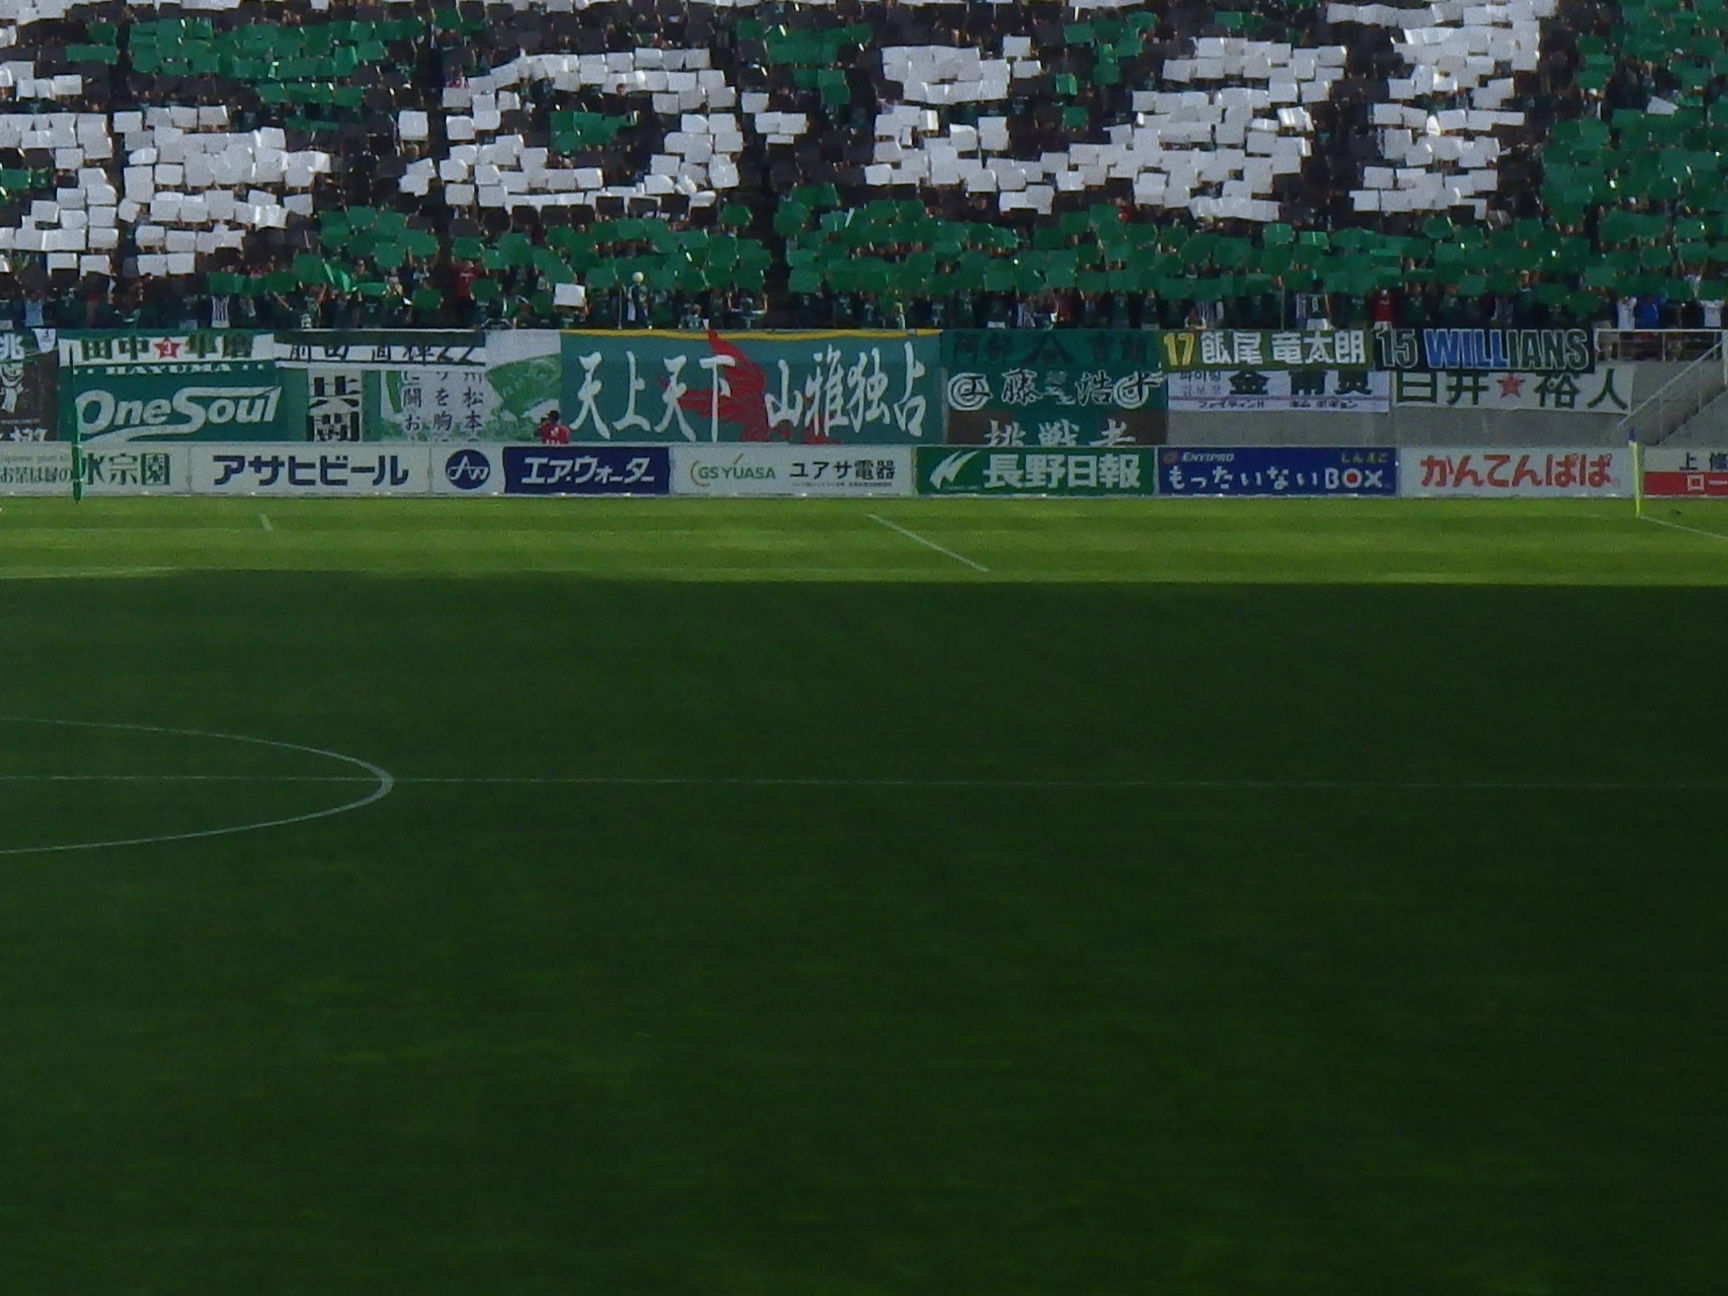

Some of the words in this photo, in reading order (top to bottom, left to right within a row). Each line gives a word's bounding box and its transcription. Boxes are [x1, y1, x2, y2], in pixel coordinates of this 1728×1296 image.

[1164, 331, 1194, 367] 17
[1272, 330, 1366, 365] 竜太朗
[1376, 328, 1418, 369] 15
[1423, 328, 1590, 370] WILLIANS
[75, 386, 281, 441] OneSoul
[570, 350, 737, 443] 天上天下
[213, 454, 409, 487] アサヒビール
[698, 466, 718, 480] GS
[982, 453, 1141, 489] 長野日報
